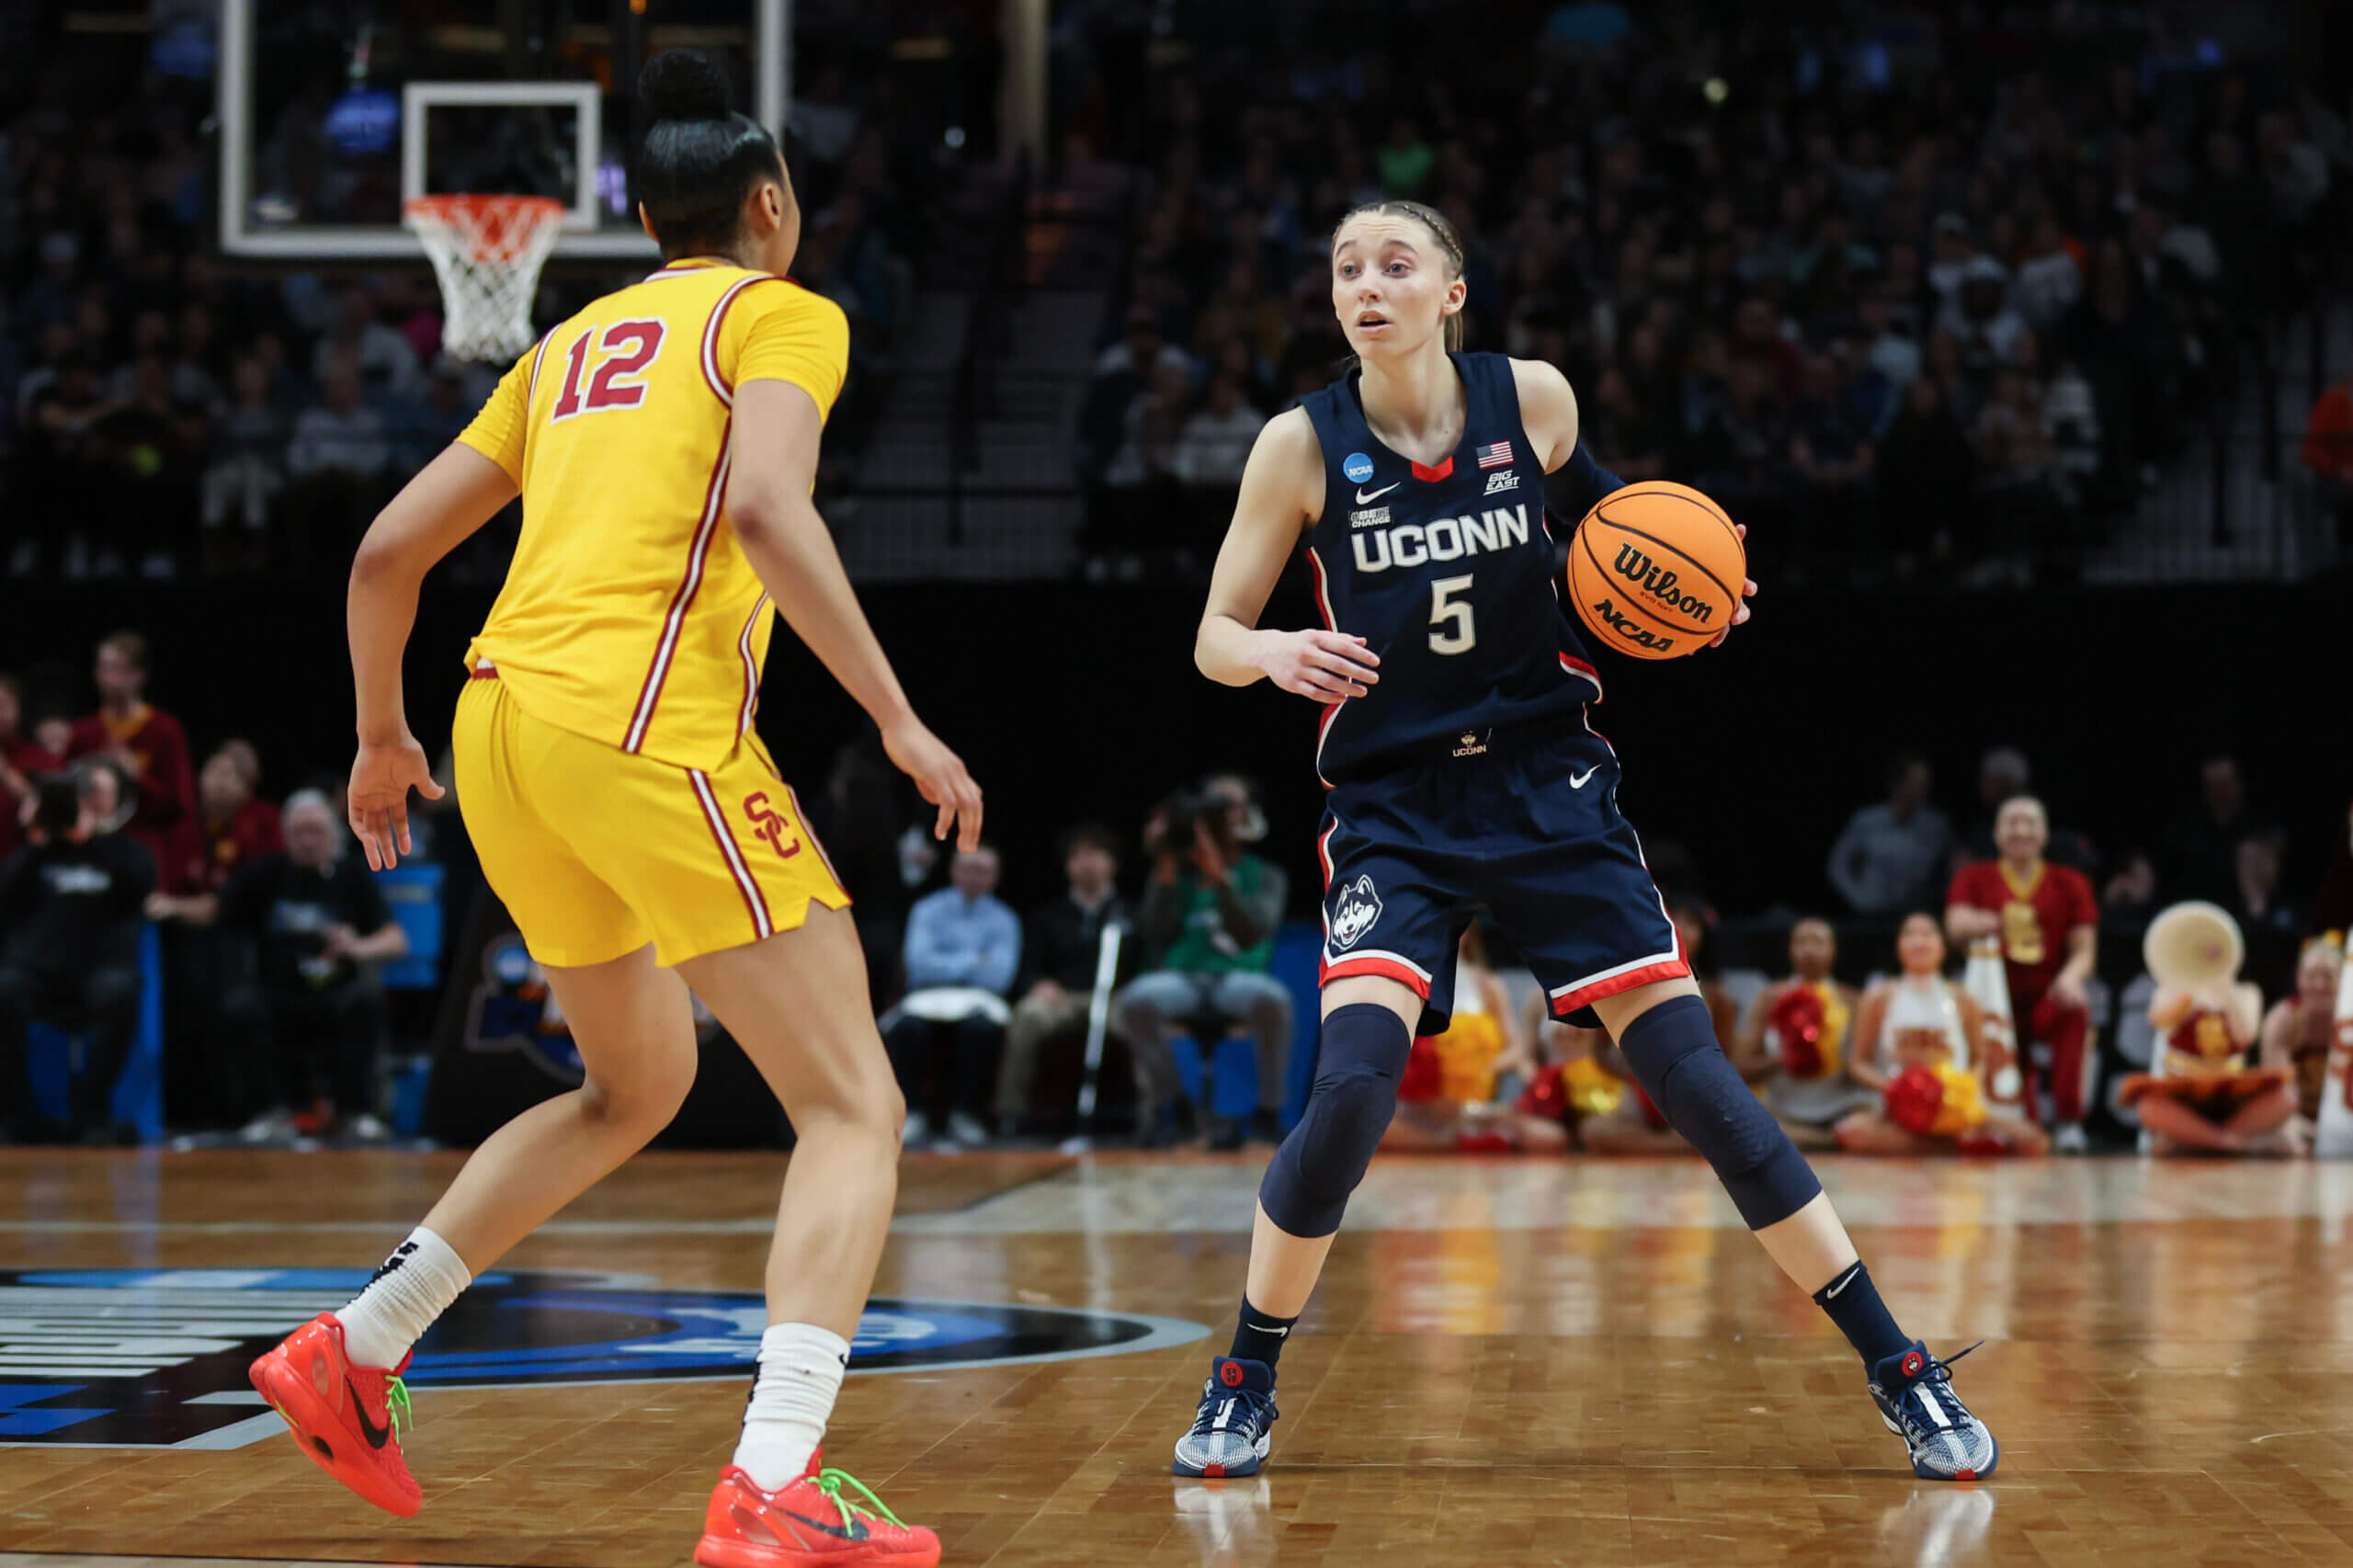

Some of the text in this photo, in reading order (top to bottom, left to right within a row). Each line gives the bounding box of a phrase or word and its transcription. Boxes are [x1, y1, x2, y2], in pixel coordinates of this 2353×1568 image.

[551, 316, 668, 426] 12
[1348, 464, 1373, 477] NCAA
[1485, 476, 1521, 491] EAST
[1488, 469, 1513, 483] BIG
[1351, 515, 1391, 528] CHANGE
[1351, 504, 1529, 573] UCONN
[1614, 540, 1713, 624] Wilson
[1428, 573, 1476, 655] 5
[1594, 598, 1674, 653] NCAA
[1452, 744, 1487, 757] UCONN
